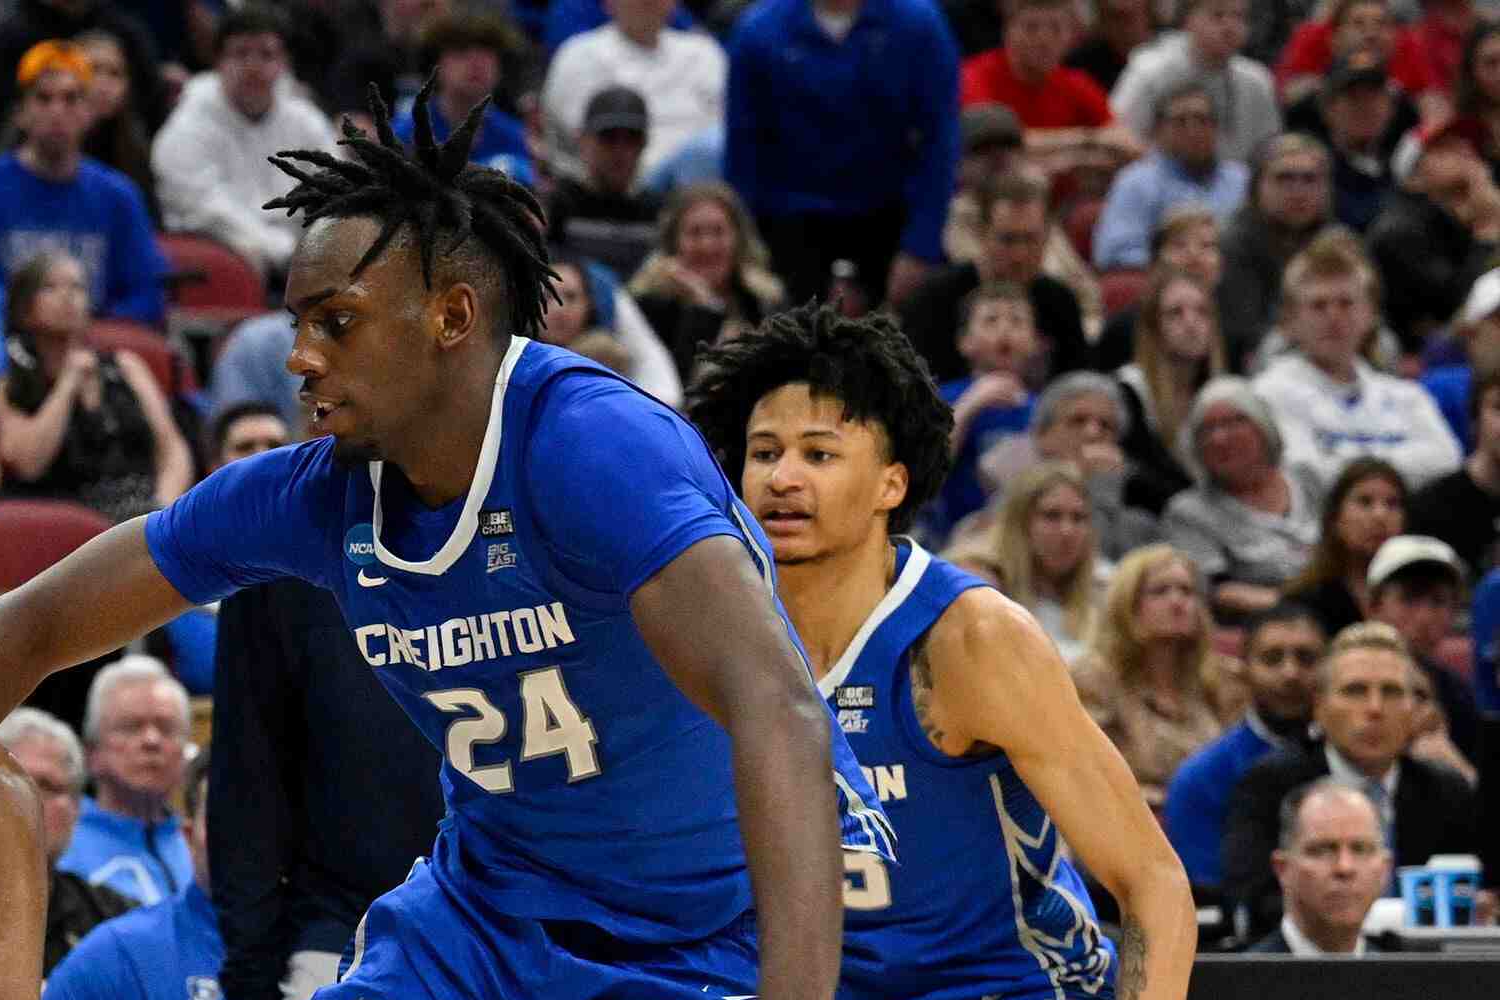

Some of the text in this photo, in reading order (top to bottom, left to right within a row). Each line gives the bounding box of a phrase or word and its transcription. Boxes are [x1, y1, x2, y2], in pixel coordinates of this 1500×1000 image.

[487, 552, 517, 567] EAST
[354, 602, 576, 672] CREIGHTON
[420, 664, 602, 794] 24
